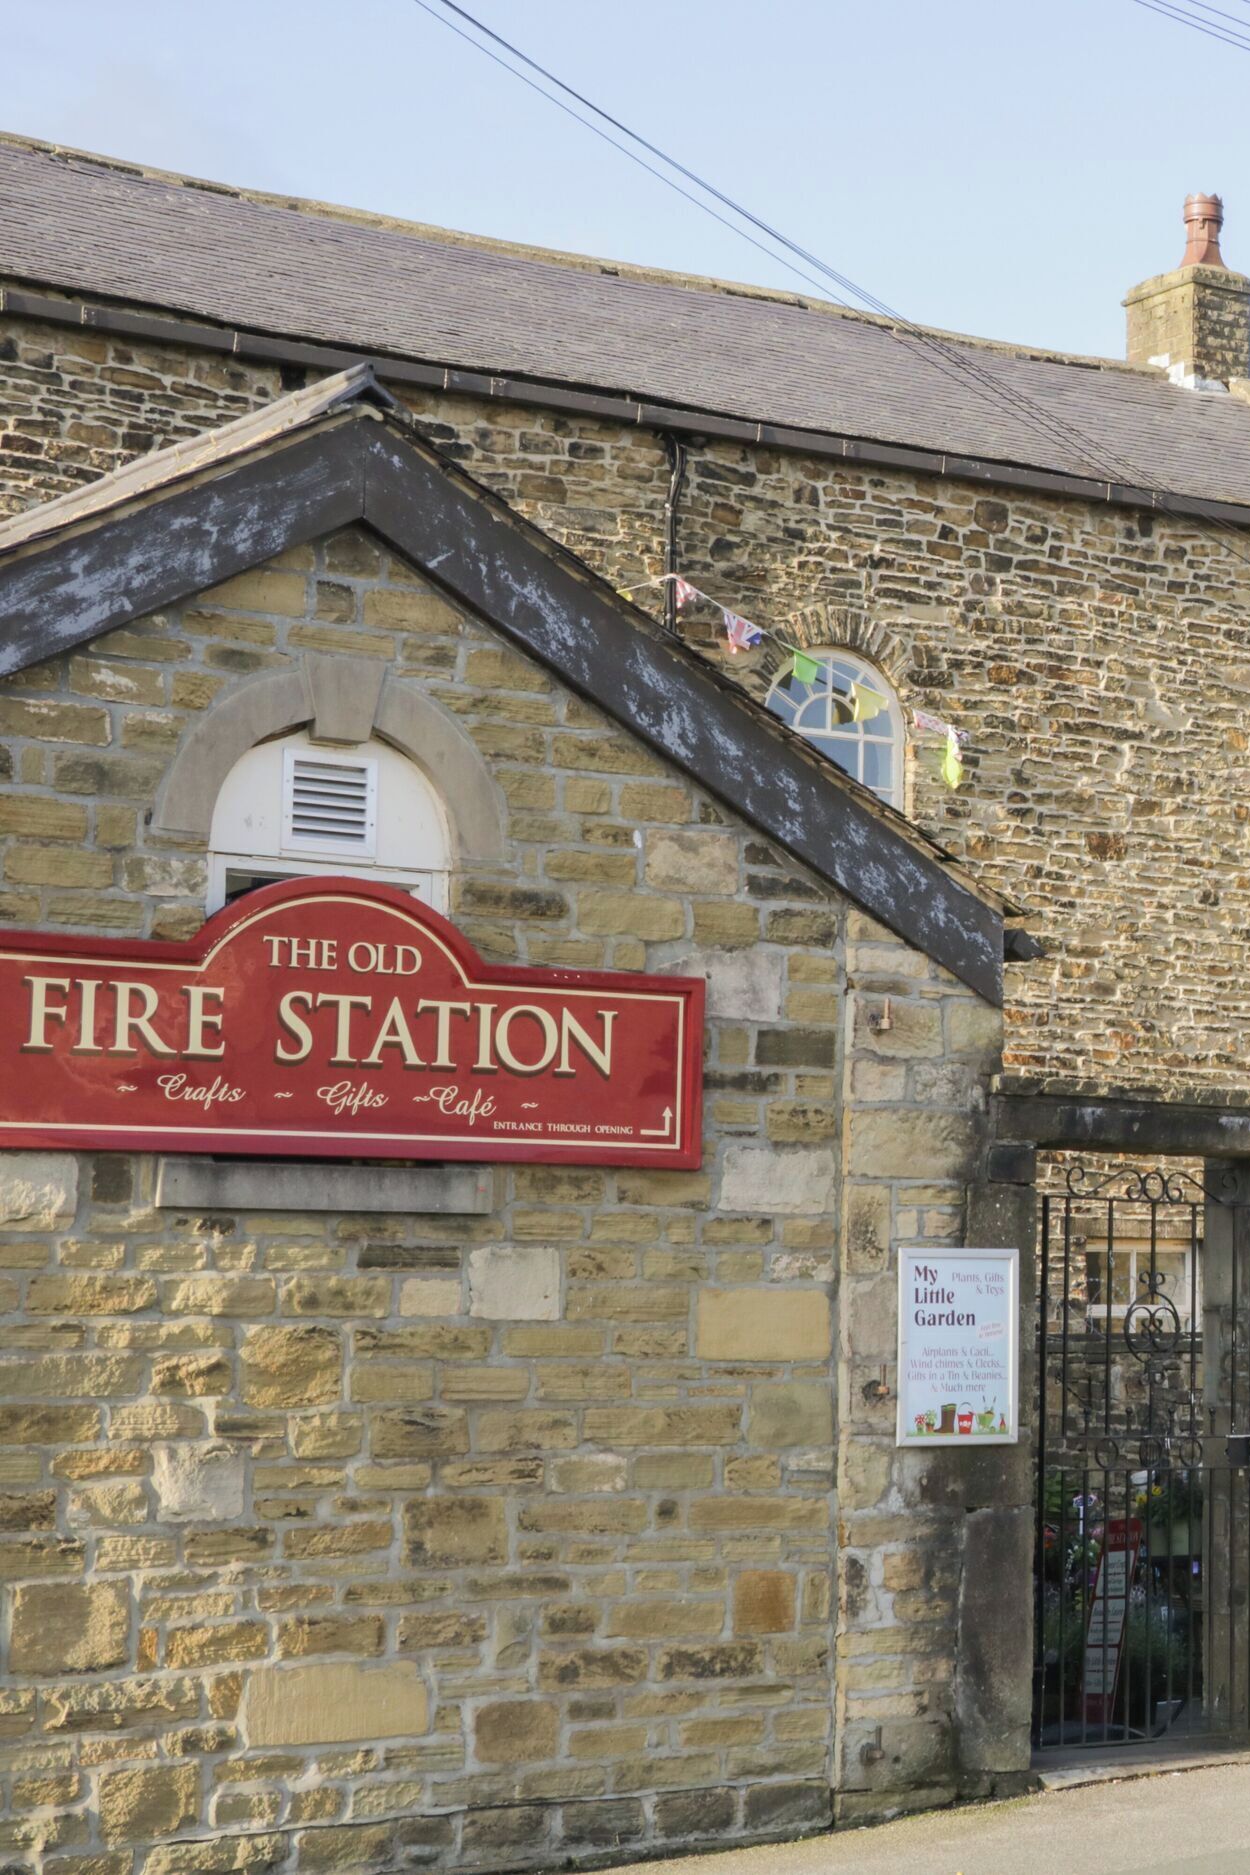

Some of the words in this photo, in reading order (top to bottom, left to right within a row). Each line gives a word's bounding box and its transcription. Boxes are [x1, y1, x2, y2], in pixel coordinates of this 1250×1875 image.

[263, 935, 338, 972] THE
[348, 941, 422, 976] OLD
[22, 976, 225, 1057] FIRE
[275, 990, 618, 1078] STATION
[157, 1073, 247, 1110] Crafts
[317, 1081, 389, 1115] Gifts
[429, 1085, 497, 1126] Café
[493, 1120, 543, 1132] ENTRANCE
[547, 1122, 591, 1134] THROUGH
[595, 1124, 633, 1135] OPENING
[914, 1265, 938, 1286] My
[952, 1271, 982, 1283] Plants,
[984, 1271, 1005, 1283] Gifts
[914, 1287, 955, 1304] Little
[976, 1284, 983, 1295] &
[985, 1284, 1005, 1296] Toys
[914, 1309, 976, 1327] Garden
[922, 1346, 958, 1358] Airplants
[961, 1346, 968, 1357] &
[910, 1359, 932, 1369] Wind
[934, 1358, 964, 1369] chimes
[967, 1359, 973, 1369] &
[907, 1370, 926, 1380] Gifts
[929, 1370, 937, 1380] in
[939, 1372, 945, 1380] a
[947, 1370, 960, 1380] Tin
[963, 1370, 970, 1380] &
[930, 1383, 938, 1393] &
[940, 1382, 963, 1393] Much
[965, 1383, 986, 1393] more
